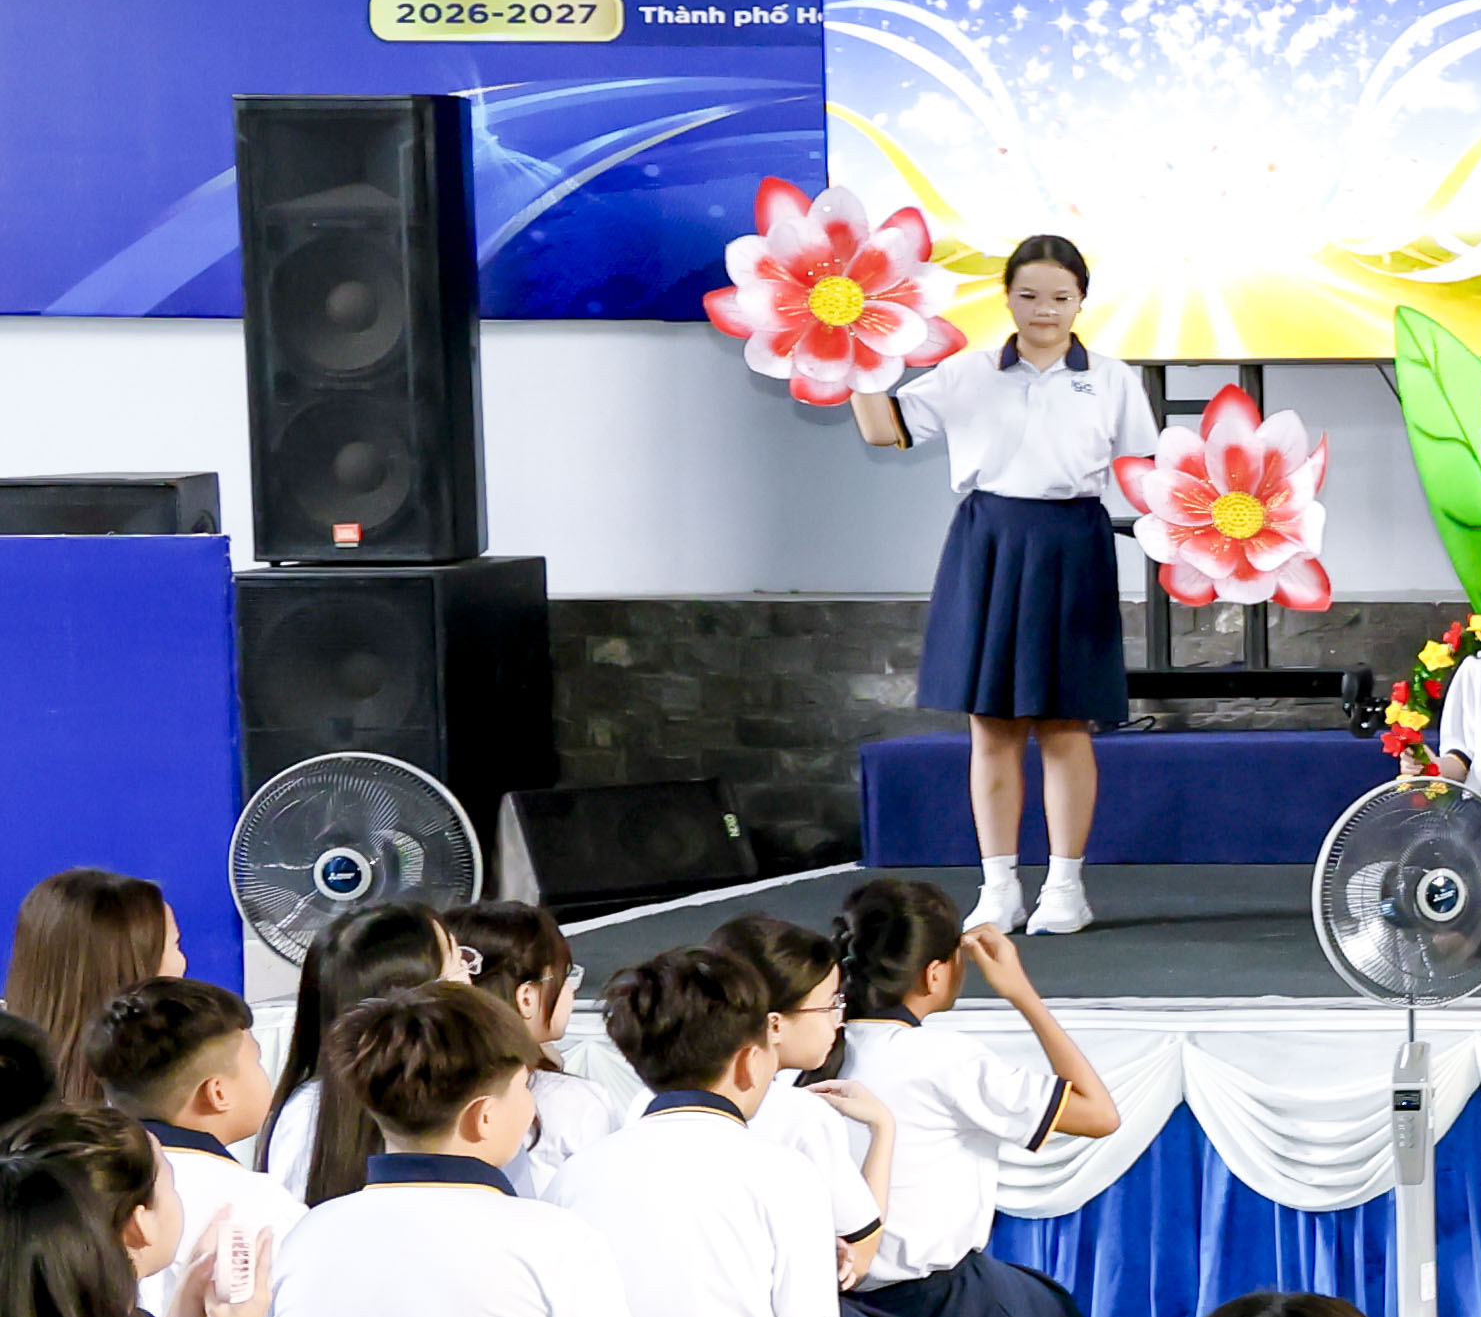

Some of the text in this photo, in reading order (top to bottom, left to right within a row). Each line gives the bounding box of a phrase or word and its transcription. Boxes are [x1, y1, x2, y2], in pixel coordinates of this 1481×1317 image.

[396, 3, 600, 26] 2026-2027
[639, 5, 727, 25] Thành
[735, 3, 792, 28] phố
